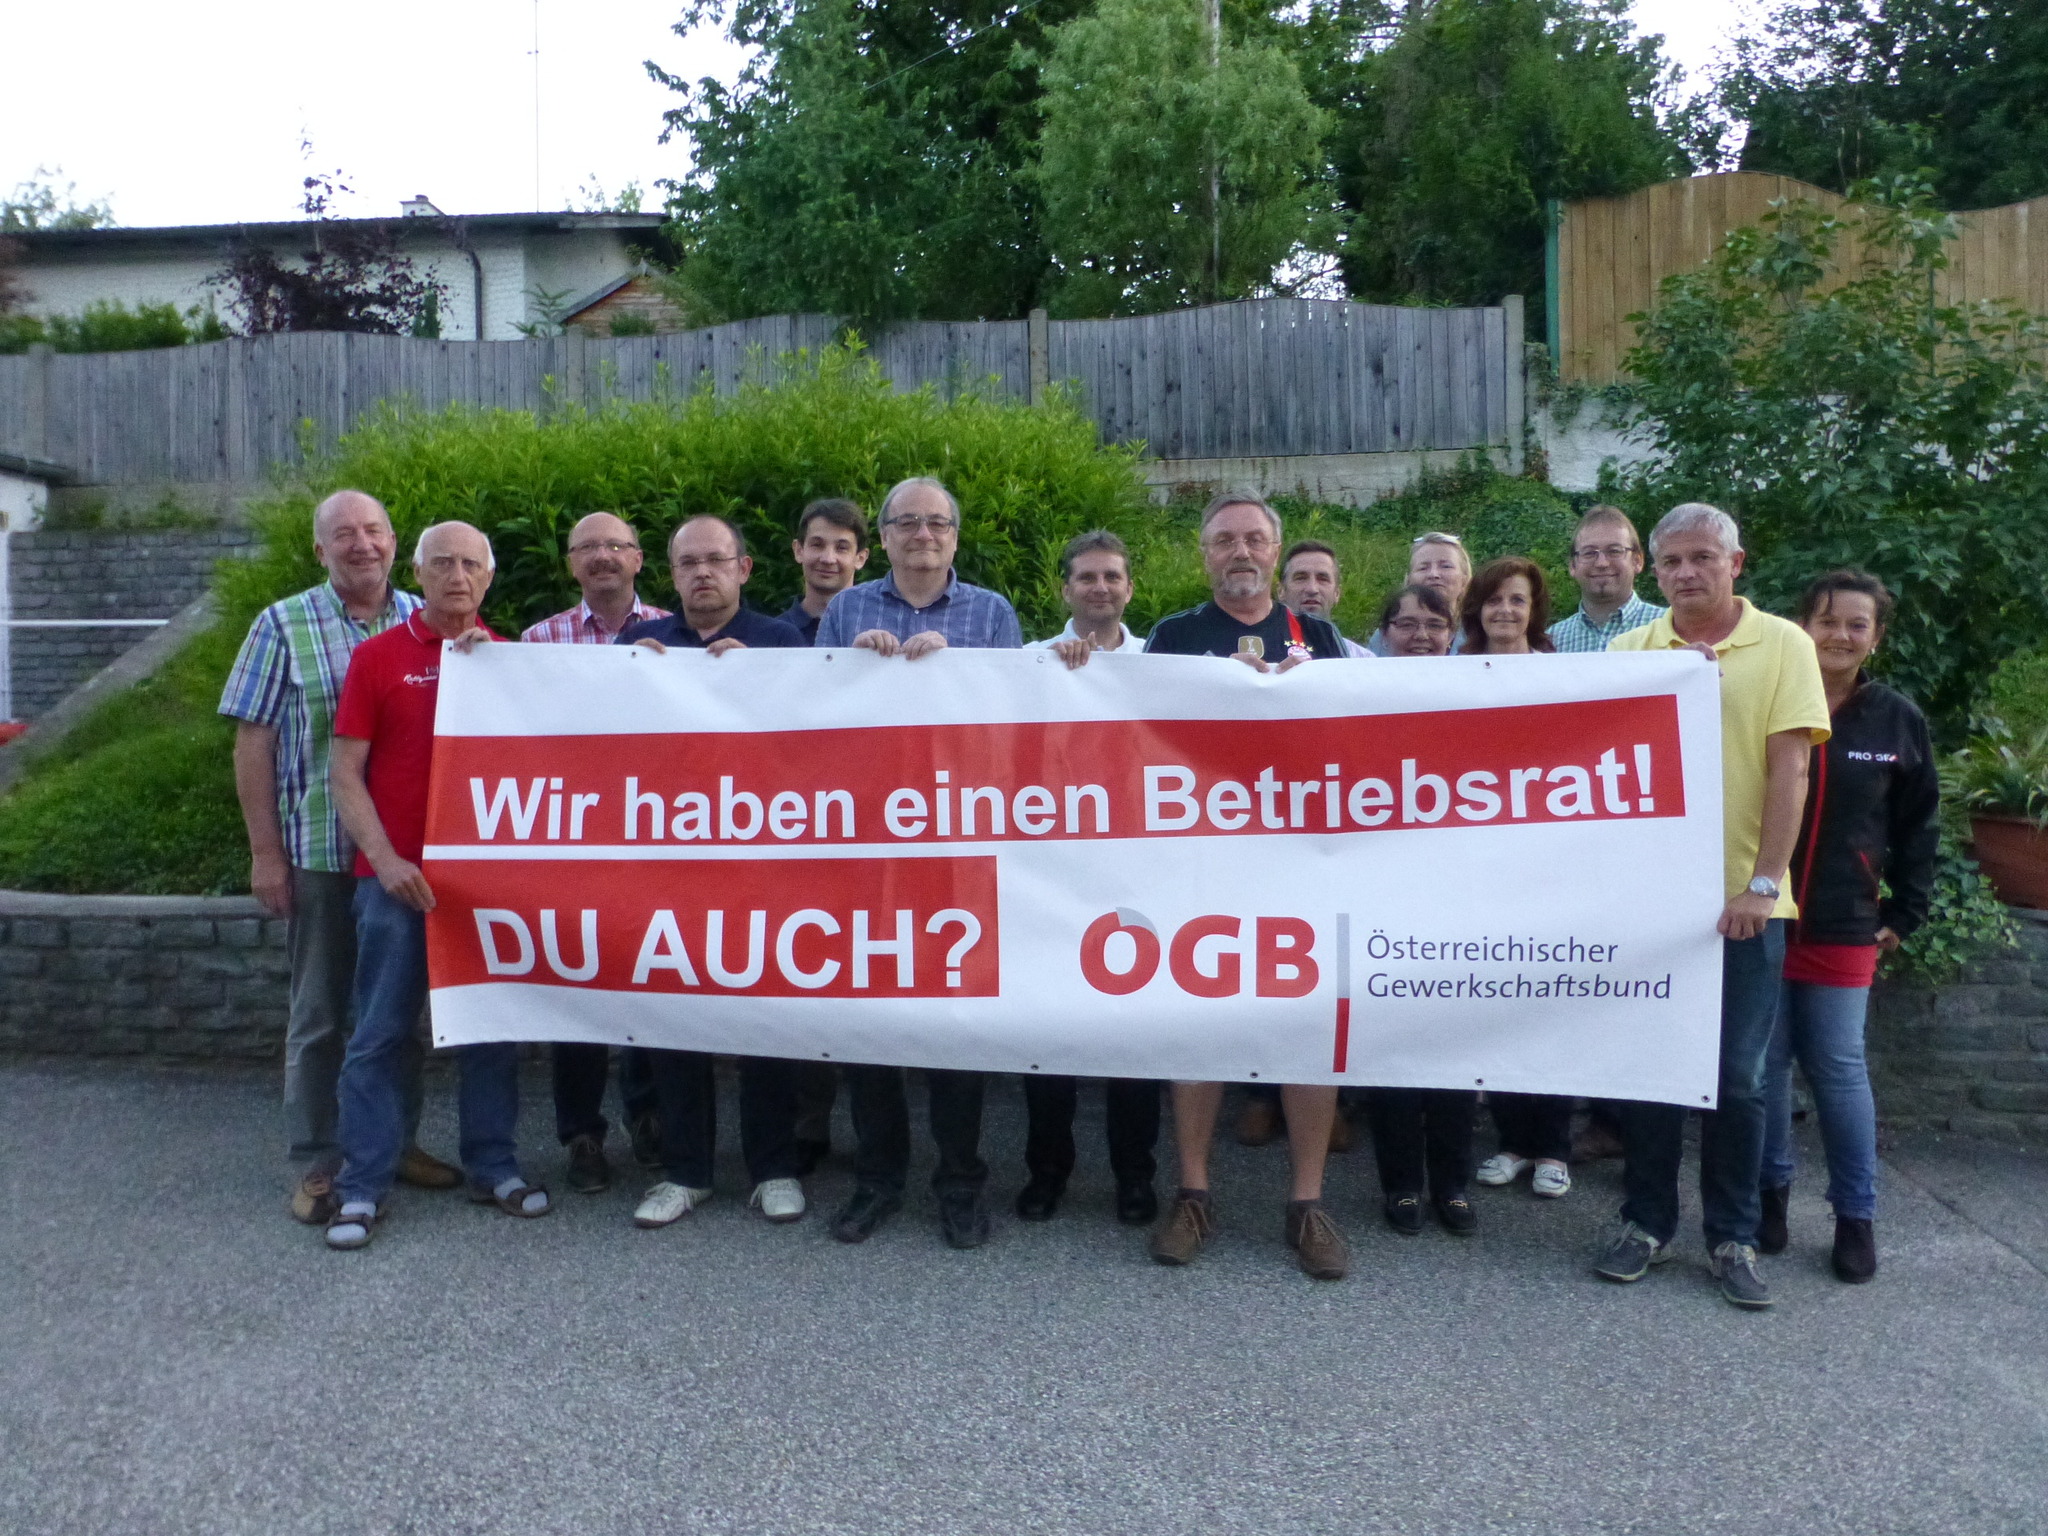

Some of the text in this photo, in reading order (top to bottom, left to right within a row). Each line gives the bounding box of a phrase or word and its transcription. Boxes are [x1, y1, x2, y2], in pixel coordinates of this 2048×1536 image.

[1847, 750, 1873, 761] PRO
[469, 743, 1656, 841] Wir haben einen Betriebsrat!
[472, 908, 982, 989] DU AUCH?
[1367, 929, 1619, 963] Österreichischer
[1367, 972, 1671, 999] Gewerkschaftsbund
